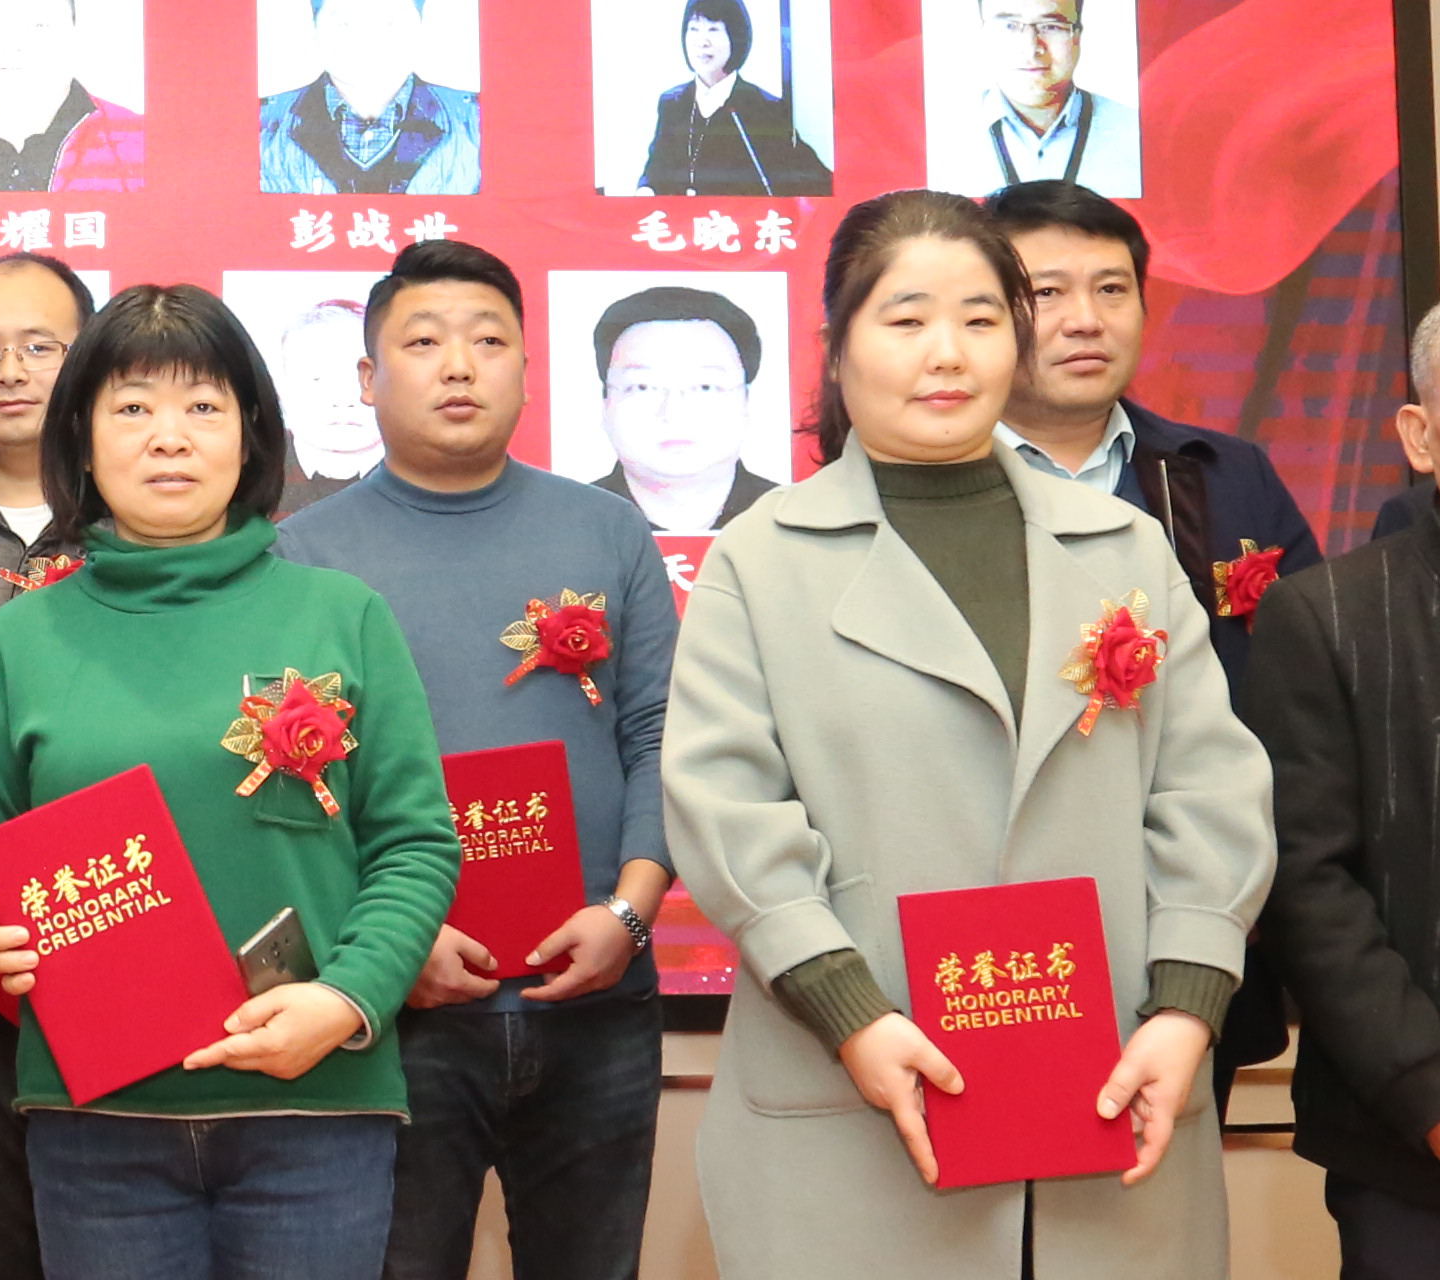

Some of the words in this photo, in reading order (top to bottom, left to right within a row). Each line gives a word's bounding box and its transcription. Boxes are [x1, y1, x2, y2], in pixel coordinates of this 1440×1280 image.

[631, 210, 797, 254] 毛晓东
[448, 791, 549, 830] 誉证书
[458, 824, 545, 848] ONORARY
[464, 838, 554, 863] EDENTIAL
[20, 833, 154, 921] 荣誉证书
[36, 874, 154, 937] HONORARY
[36, 890, 172, 957] CREDENTIAL
[934, 941, 1077, 995] 荣誉证书
[940, 1000, 1084, 1032] CREDENTIAL
[945, 985, 1071, 1012] HONORARY
